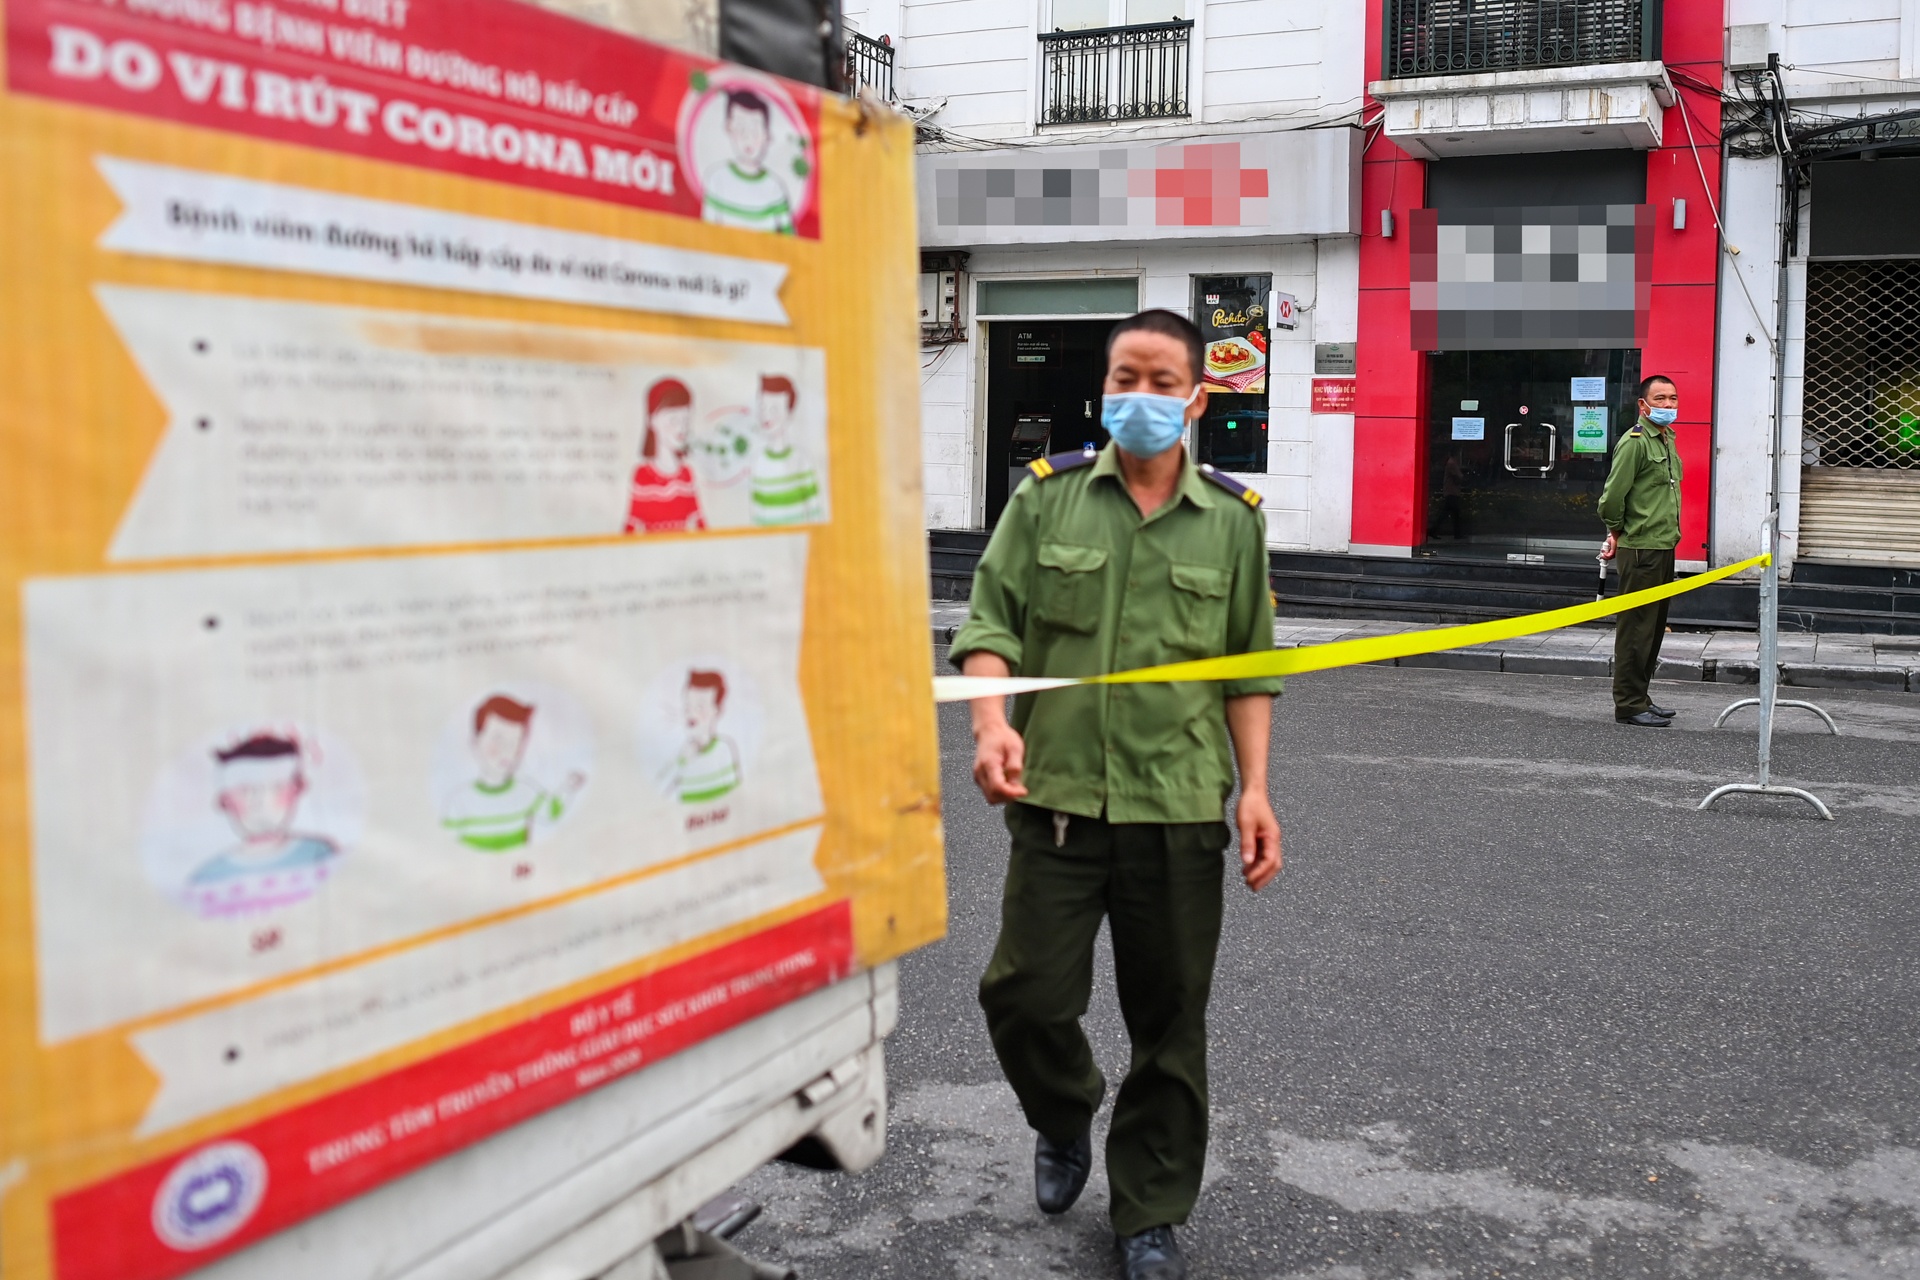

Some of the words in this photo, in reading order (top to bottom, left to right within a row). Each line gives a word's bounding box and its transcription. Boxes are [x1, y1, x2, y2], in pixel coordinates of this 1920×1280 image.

[48, 25, 163, 91] DO
[167, 50, 247, 111] VI
[253, 74, 379, 135] RÚT
[382, 100, 588, 179] CORONA
[592, 147, 676, 195] MỚI
[1212, 309, 1247, 327] Pachito
